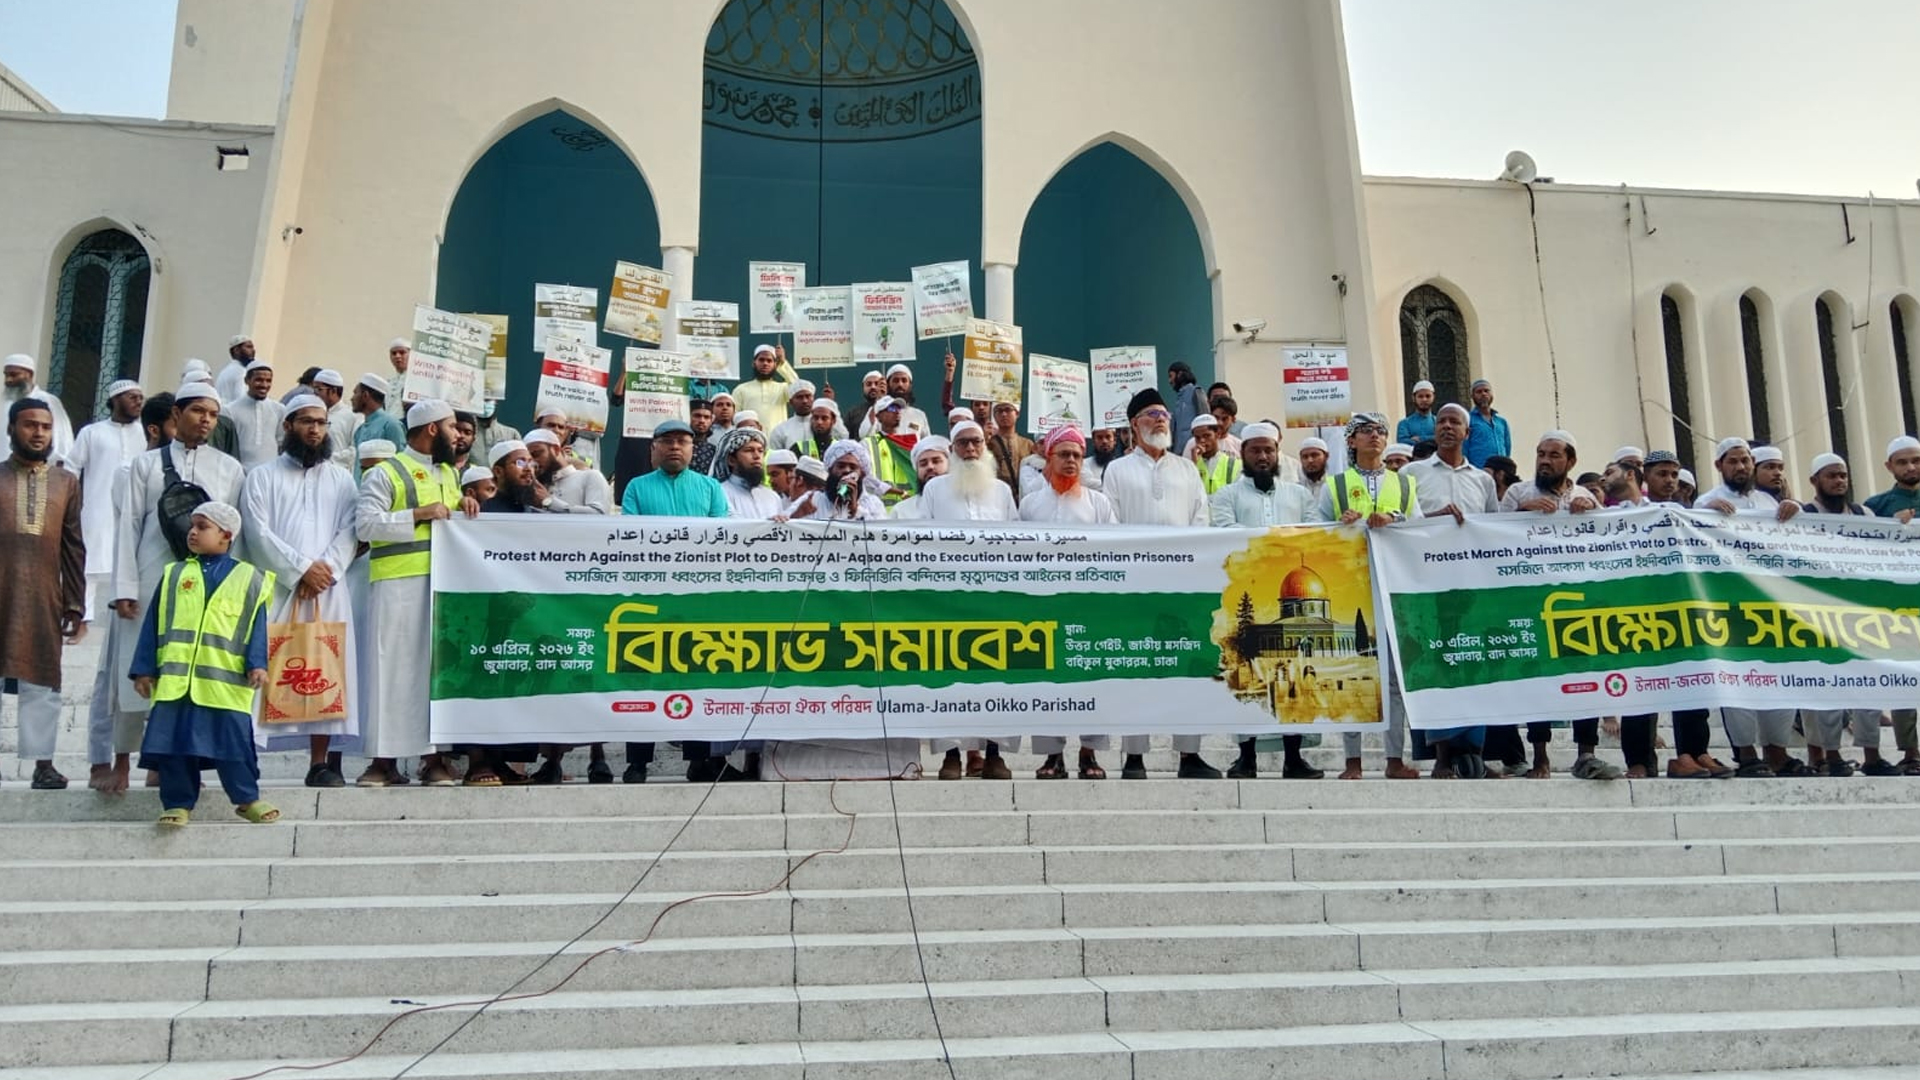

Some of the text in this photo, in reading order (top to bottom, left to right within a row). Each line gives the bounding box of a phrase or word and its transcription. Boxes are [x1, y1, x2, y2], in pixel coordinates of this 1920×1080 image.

[607, 528, 644, 545] إعدام
[649, 526, 690, 545] قانون
[799, 529, 847, 545] المسجد
[1562, 520, 1596, 538] قانون
[938, 530, 975, 545] رفضا
[979, 530, 1039, 545] احتجاجية
[1044, 533, 1088, 545] مسيرة
[484, 550, 1195, 566] Protest March Against the Zionist Plot to Destroy Al-Aqsa and the Execution Law for Palestinian Prisoners
[1424, 550, 1469, 563] Protest
[1471, 547, 1513, 560] March
[1515, 544, 1563, 559] Against
[1566, 543, 1586, 554] the
[1588, 541, 1627, 553] Zionist
[1630, 539, 1654, 550] Plot
[1654, 539, 1665, 548] to
[565, 567, 619, 583] মসজিদে
[622, 570, 666, 583] আকসা
[671, 571, 722, 583] ধ্বংসের
[787, 571, 826, 584] চক্রান্ত
[829, 571, 840, 583] ও
[844, 567, 903, 584] ফিলিস্তিনি
[906, 567, 956, 583] বন্দিদের
[1023, 568, 1071, 583] আইনের
[1075, 566, 1126, 583] প্রতিবাদে
[1497, 561, 1544, 576] মসজিদে
[1547, 561, 1585, 573] আকসা
[1541, 591, 1920, 658] বিক্ষোভ সমাবেশ
[603, 602, 1058, 674] বিক্ষোভ সমাবেশ
[1164, 637, 1201, 651] মসজিদ
[1429, 639, 1443, 650] ১০
[1488, 634, 1518, 646] ২০২৬
[470, 643, 487, 655] ১০
[539, 643, 574, 655] ২০২৬
[577, 640, 595, 656] ইং
[1487, 650, 1506, 660] বাদ
[1508, 647, 1538, 658] আসর
[535, 659, 557, 671] বাদ
[560, 659, 593, 671] আসর
[1154, 656, 1178, 668] ঢাকা
[1635, 672, 1715, 692] উলামা-জনতা
[1742, 668, 1779, 688] পরিষদ
[1781, 673, 1876, 687] Ulama-Janata
[1879, 673, 1918, 687] Oikko
[703, 694, 1096, 716] উলামা-জনতা ঐক্য পরিষদ Ulama-Janata Oikko Parishad
